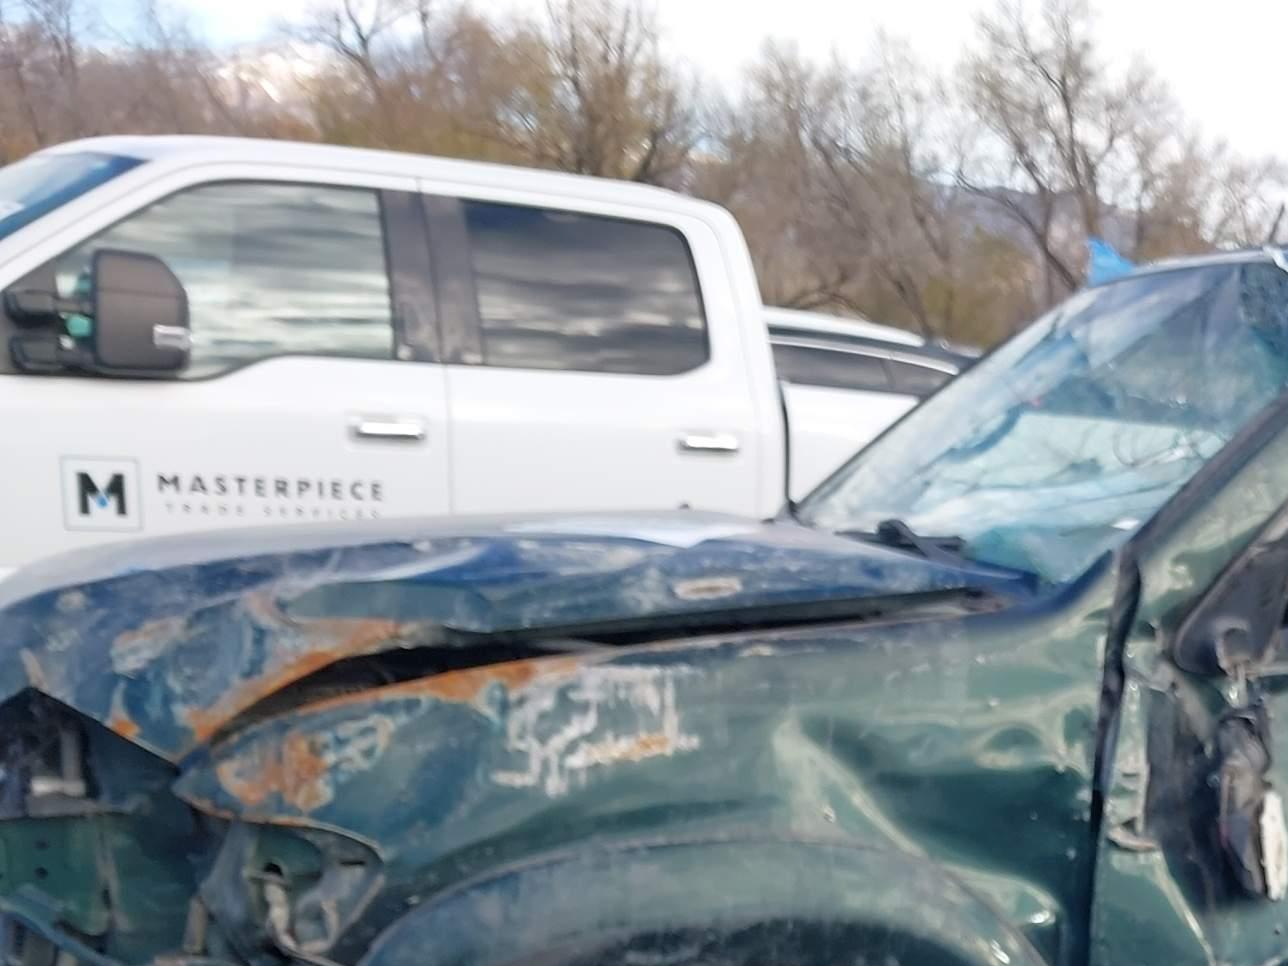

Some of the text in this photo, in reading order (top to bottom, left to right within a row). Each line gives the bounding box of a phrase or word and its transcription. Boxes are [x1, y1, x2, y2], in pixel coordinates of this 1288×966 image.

[76, 471, 127, 516] M
[156, 474, 385, 502] MASTERPIECE
[164, 502, 381, 521] TRADE SERVICES
